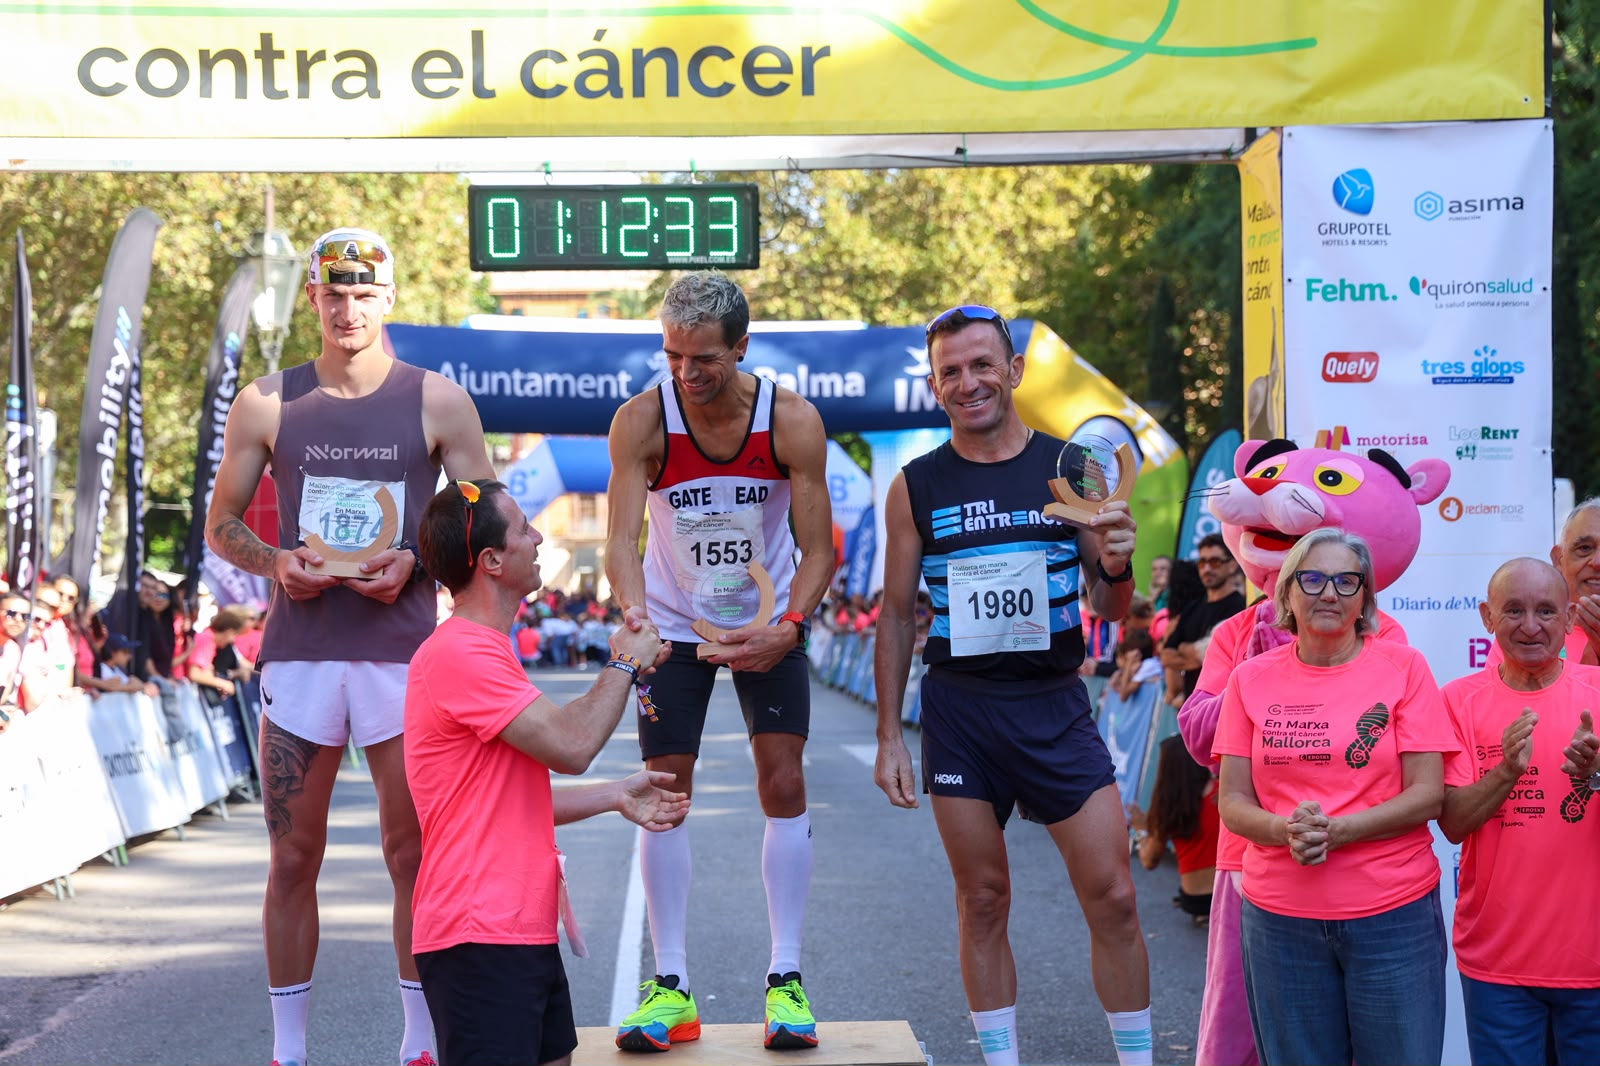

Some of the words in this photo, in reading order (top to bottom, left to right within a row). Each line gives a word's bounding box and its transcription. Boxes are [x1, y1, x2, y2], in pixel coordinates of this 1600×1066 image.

[77, 32, 381, 100] contra
[411, 29, 496, 99] el
[520, 28, 832, 99] cáncer
[1448, 196, 1525, 214] asima
[487, 196, 738, 258] 01:12:33
[1317, 222, 1392, 236] GRUPOTEL
[1305, 277, 1398, 302] Fehm.
[1325, 356, 1377, 379] Quely
[1421, 359, 1465, 375] tres
[1471, 357, 1525, 378] glops
[1356, 433, 1428, 446] motorisa
[963, 499, 995, 517] TRI
[690, 539, 753, 566] 1553
[952, 564, 978, 572] Mallorca
[988, 561, 1008, 569] marxa
[952, 569, 973, 577] contra
[968, 588, 1034, 620] 1980
[1392, 596, 1442, 611] Diario
[1445, 594, 1461, 611] de
[1262, 729, 1288, 737] contra
[1264, 719, 1282, 728] En
[1285, 720, 1330, 730] Marxa
[1262, 735, 1331, 749] Mallorca
[934, 773, 963, 785] HOKA
